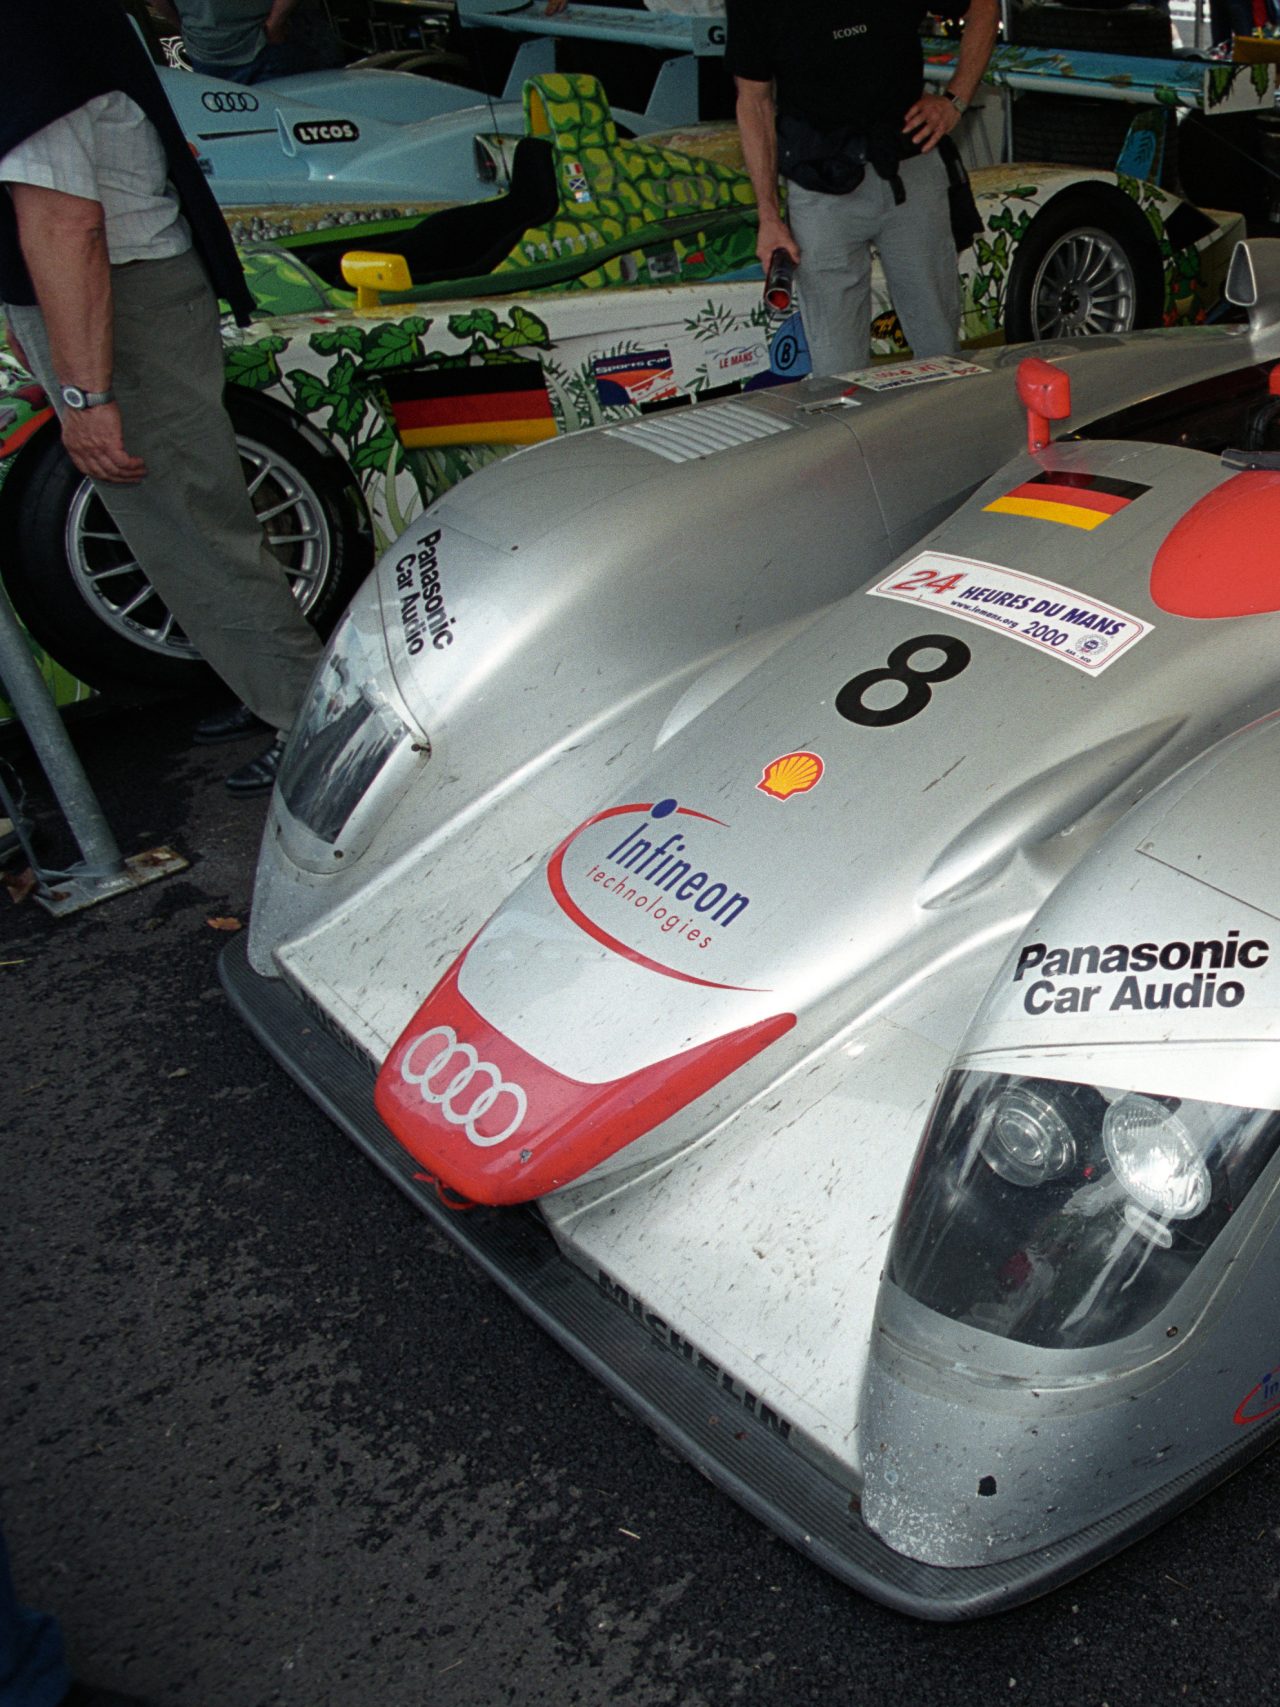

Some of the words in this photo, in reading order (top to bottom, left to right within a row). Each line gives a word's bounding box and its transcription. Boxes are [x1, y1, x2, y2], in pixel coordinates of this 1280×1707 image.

[299, 125, 354, 142] LYCOS
[595, 361, 646, 375] Sports
[719, 358, 729, 369] LE
[731, 351, 753, 366] MANS
[396, 553, 417, 592] Car
[416, 528, 456, 650] Panasonic
[401, 591, 428, 656] Audio
[890, 569, 968, 596] 24
[958, 585, 1036, 611] HEURES
[1028, 599, 1066, 618] DU
[1059, 607, 1127, 637] MANS
[950, 600, 1020, 629] www.lemans.org
[1021, 620, 1070, 648] 2000
[834, 633, 972, 728] 8
[606, 820, 750, 928] Infineon
[585, 864, 712, 949] technologies
[1012, 930, 1270, 983] Panasonic
[1023, 979, 1103, 1016] Car
[1108, 972, 1246, 1012] Audio
